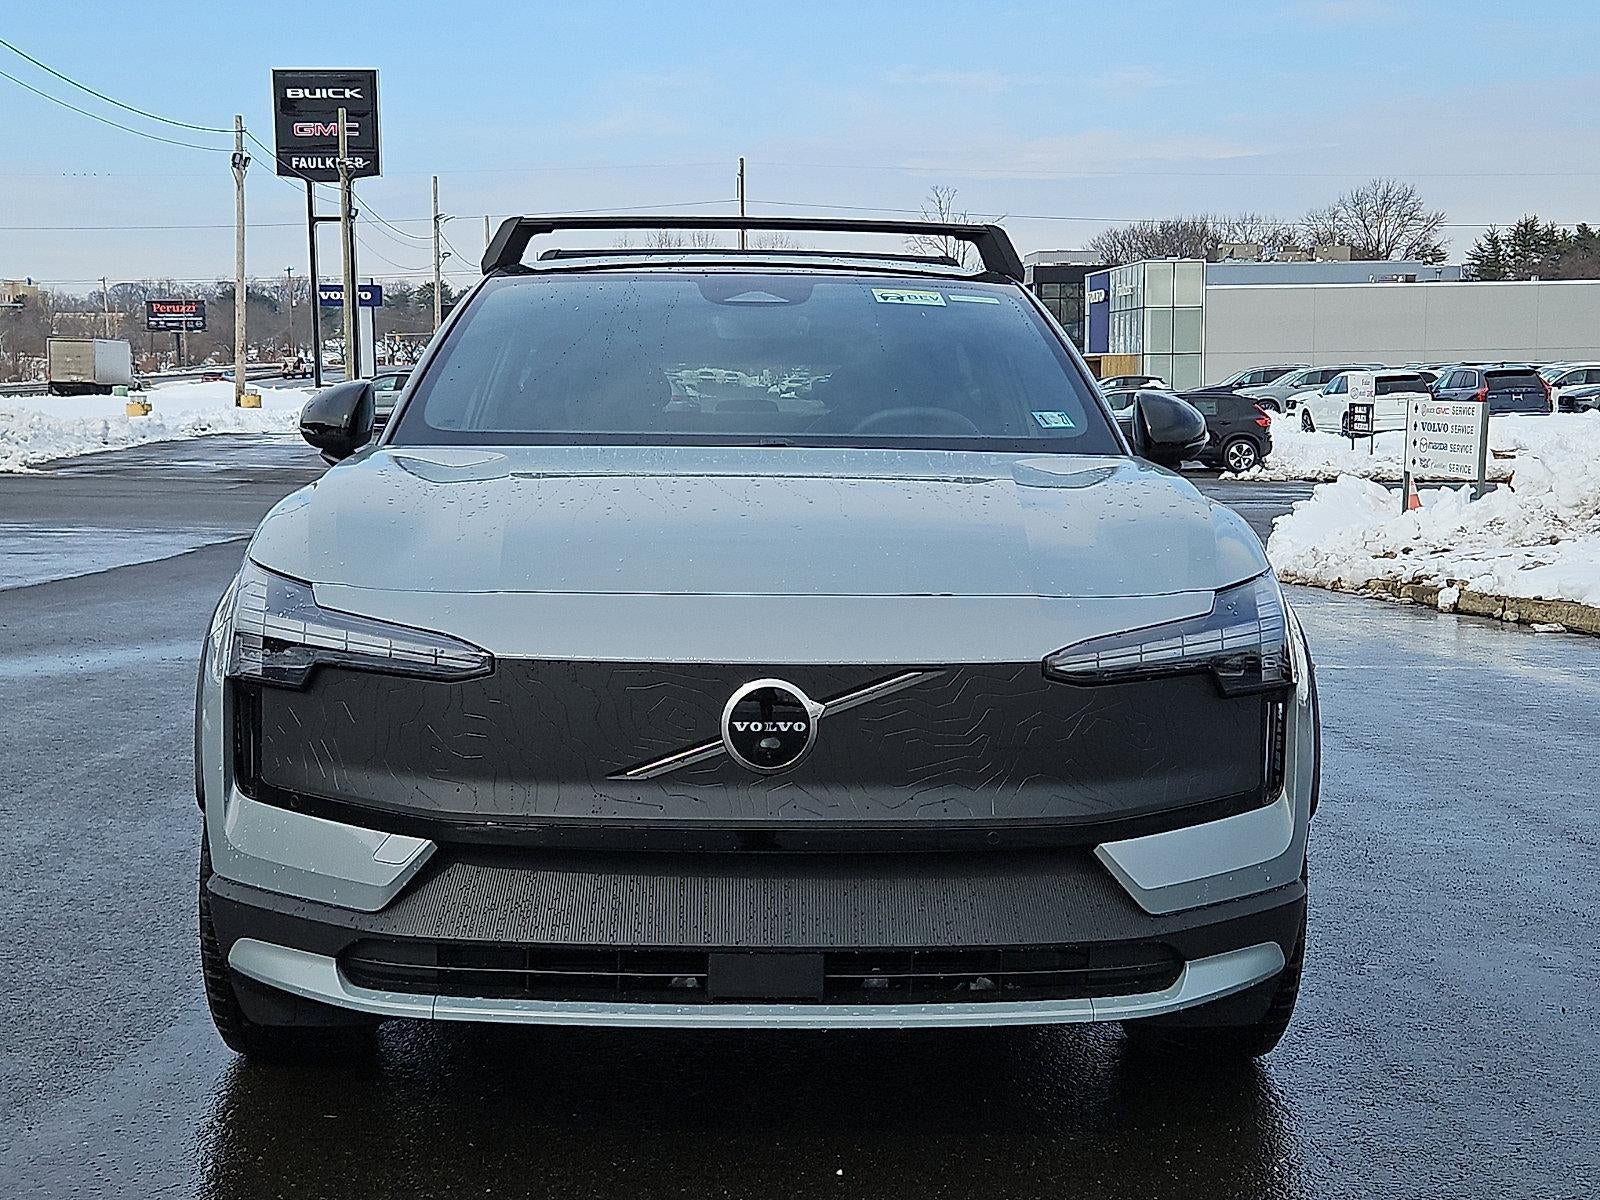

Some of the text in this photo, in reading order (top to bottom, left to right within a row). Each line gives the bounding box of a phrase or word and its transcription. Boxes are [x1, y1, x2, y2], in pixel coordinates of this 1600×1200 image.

[286, 88, 363, 99] BUICK
[293, 122, 360, 137] GMC
[319, 291, 372, 300] VOO
[152, 302, 197, 313] Peruzzi
[1452, 405, 1476, 416] SERVICE
[1421, 421, 1475, 435] VOLVO SERVICE
[1449, 443, 1473, 454] SERVICE
[1448, 463, 1472, 474] SERVICE
[732, 721, 807, 732] VOLVO
